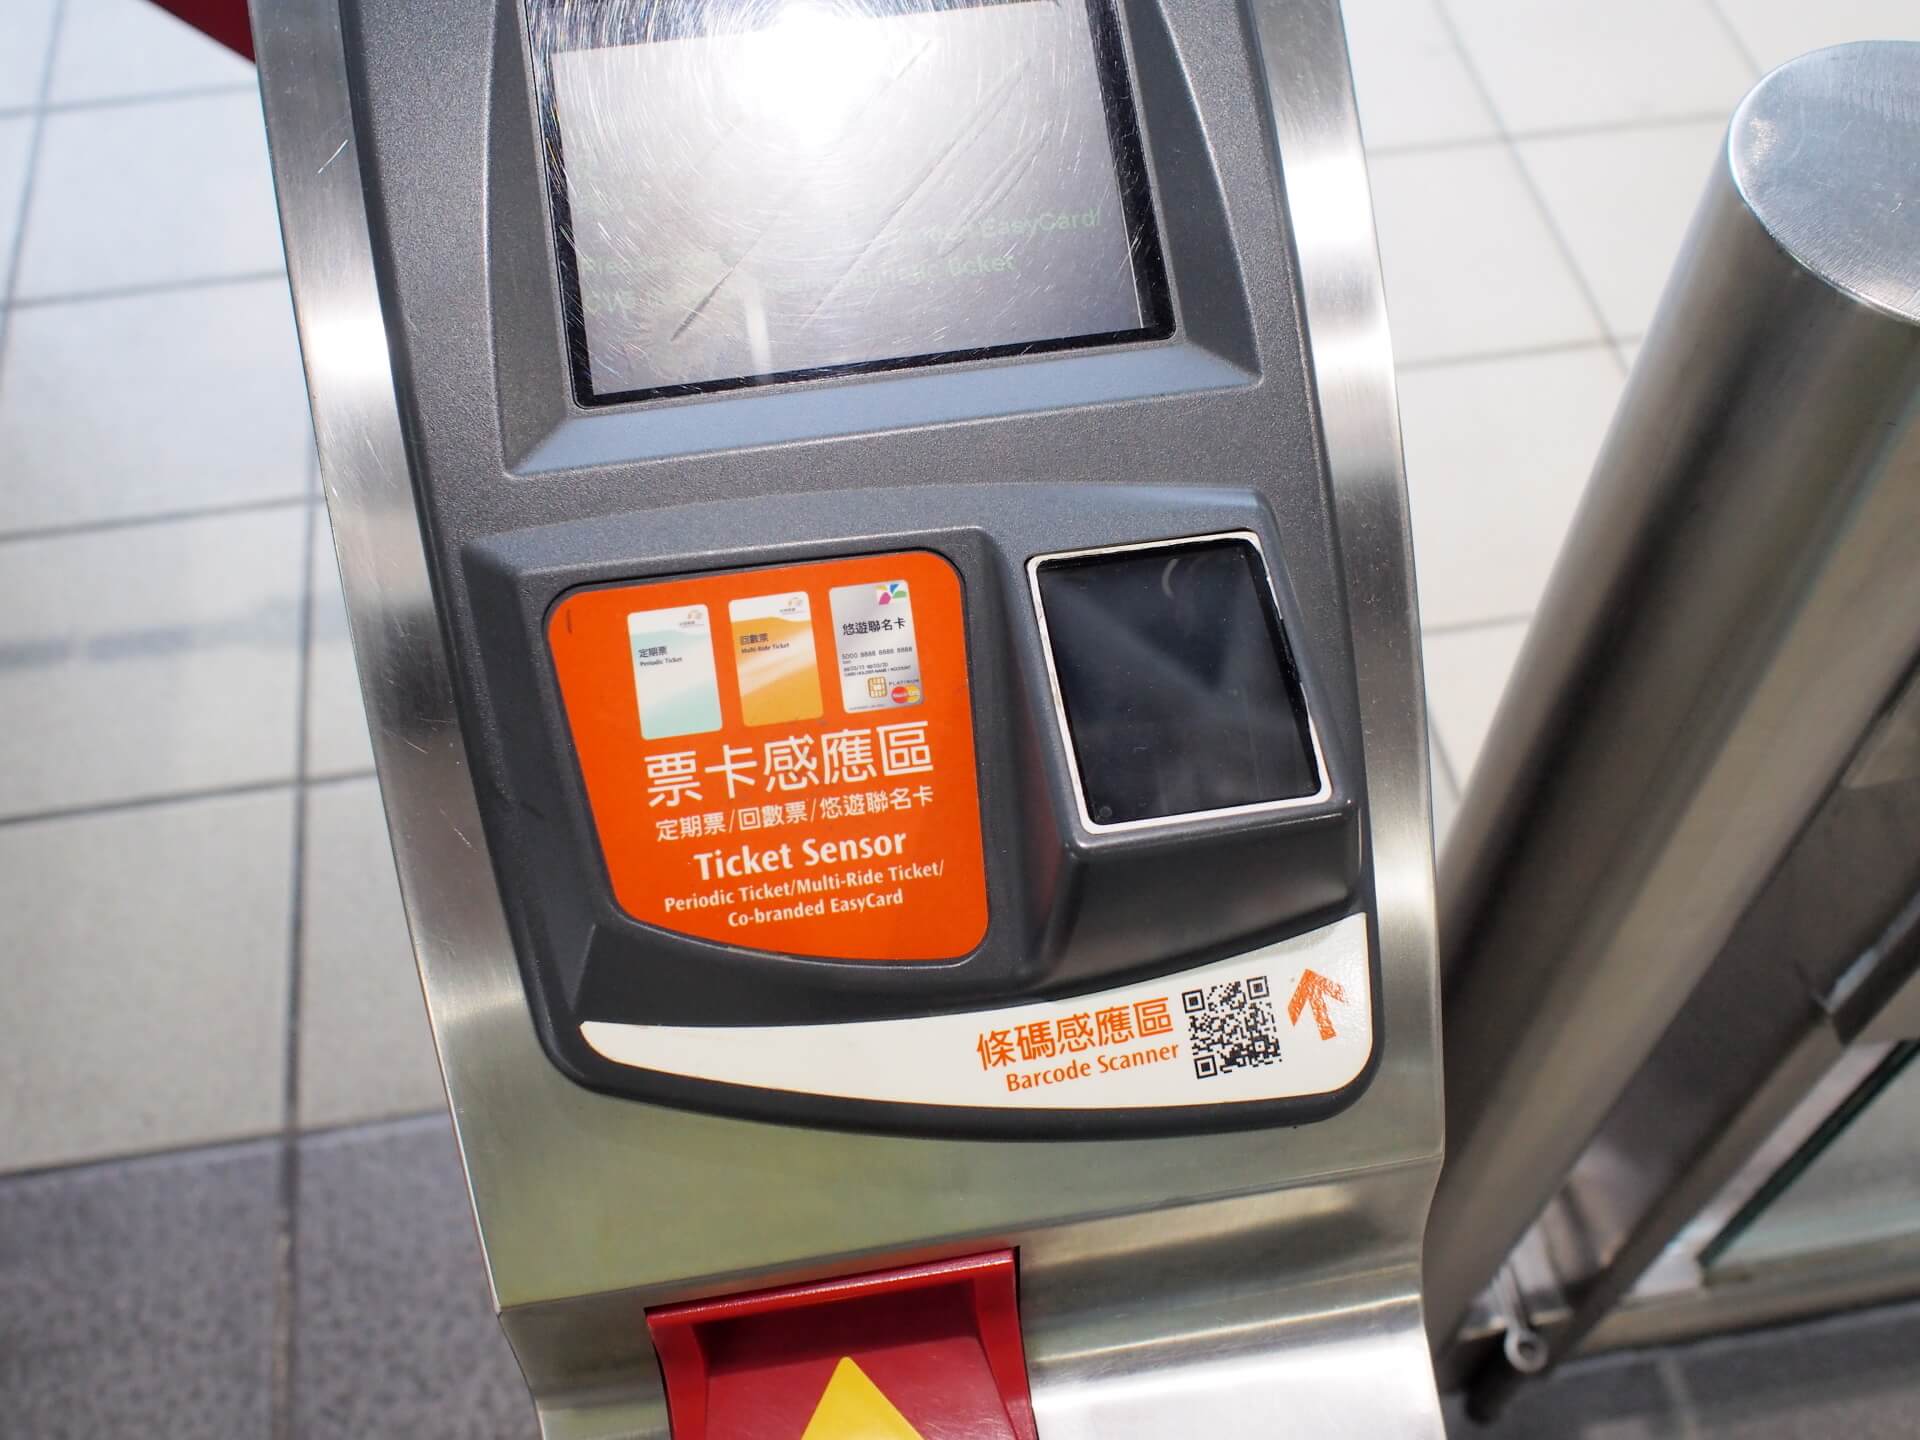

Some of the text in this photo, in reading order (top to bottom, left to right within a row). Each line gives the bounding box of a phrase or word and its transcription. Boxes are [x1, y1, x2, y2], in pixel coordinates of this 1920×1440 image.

[842, 617, 906, 636] 悠遊聯名卡
[644, 720, 934, 808] 票卡感應區
[655, 785, 934, 842] 定期票/回數票/悠遊聯名卡
[693, 832, 907, 881] Ticket Sensor
[664, 859, 944, 912] Periodic Ticket/Multi-Ride Ticket/
[728, 888, 904, 927] Co-branded EasyCard
[976, 997, 1174, 1071] 條碼感應區
[1006, 1043, 1179, 1092] Barcode Scanner
